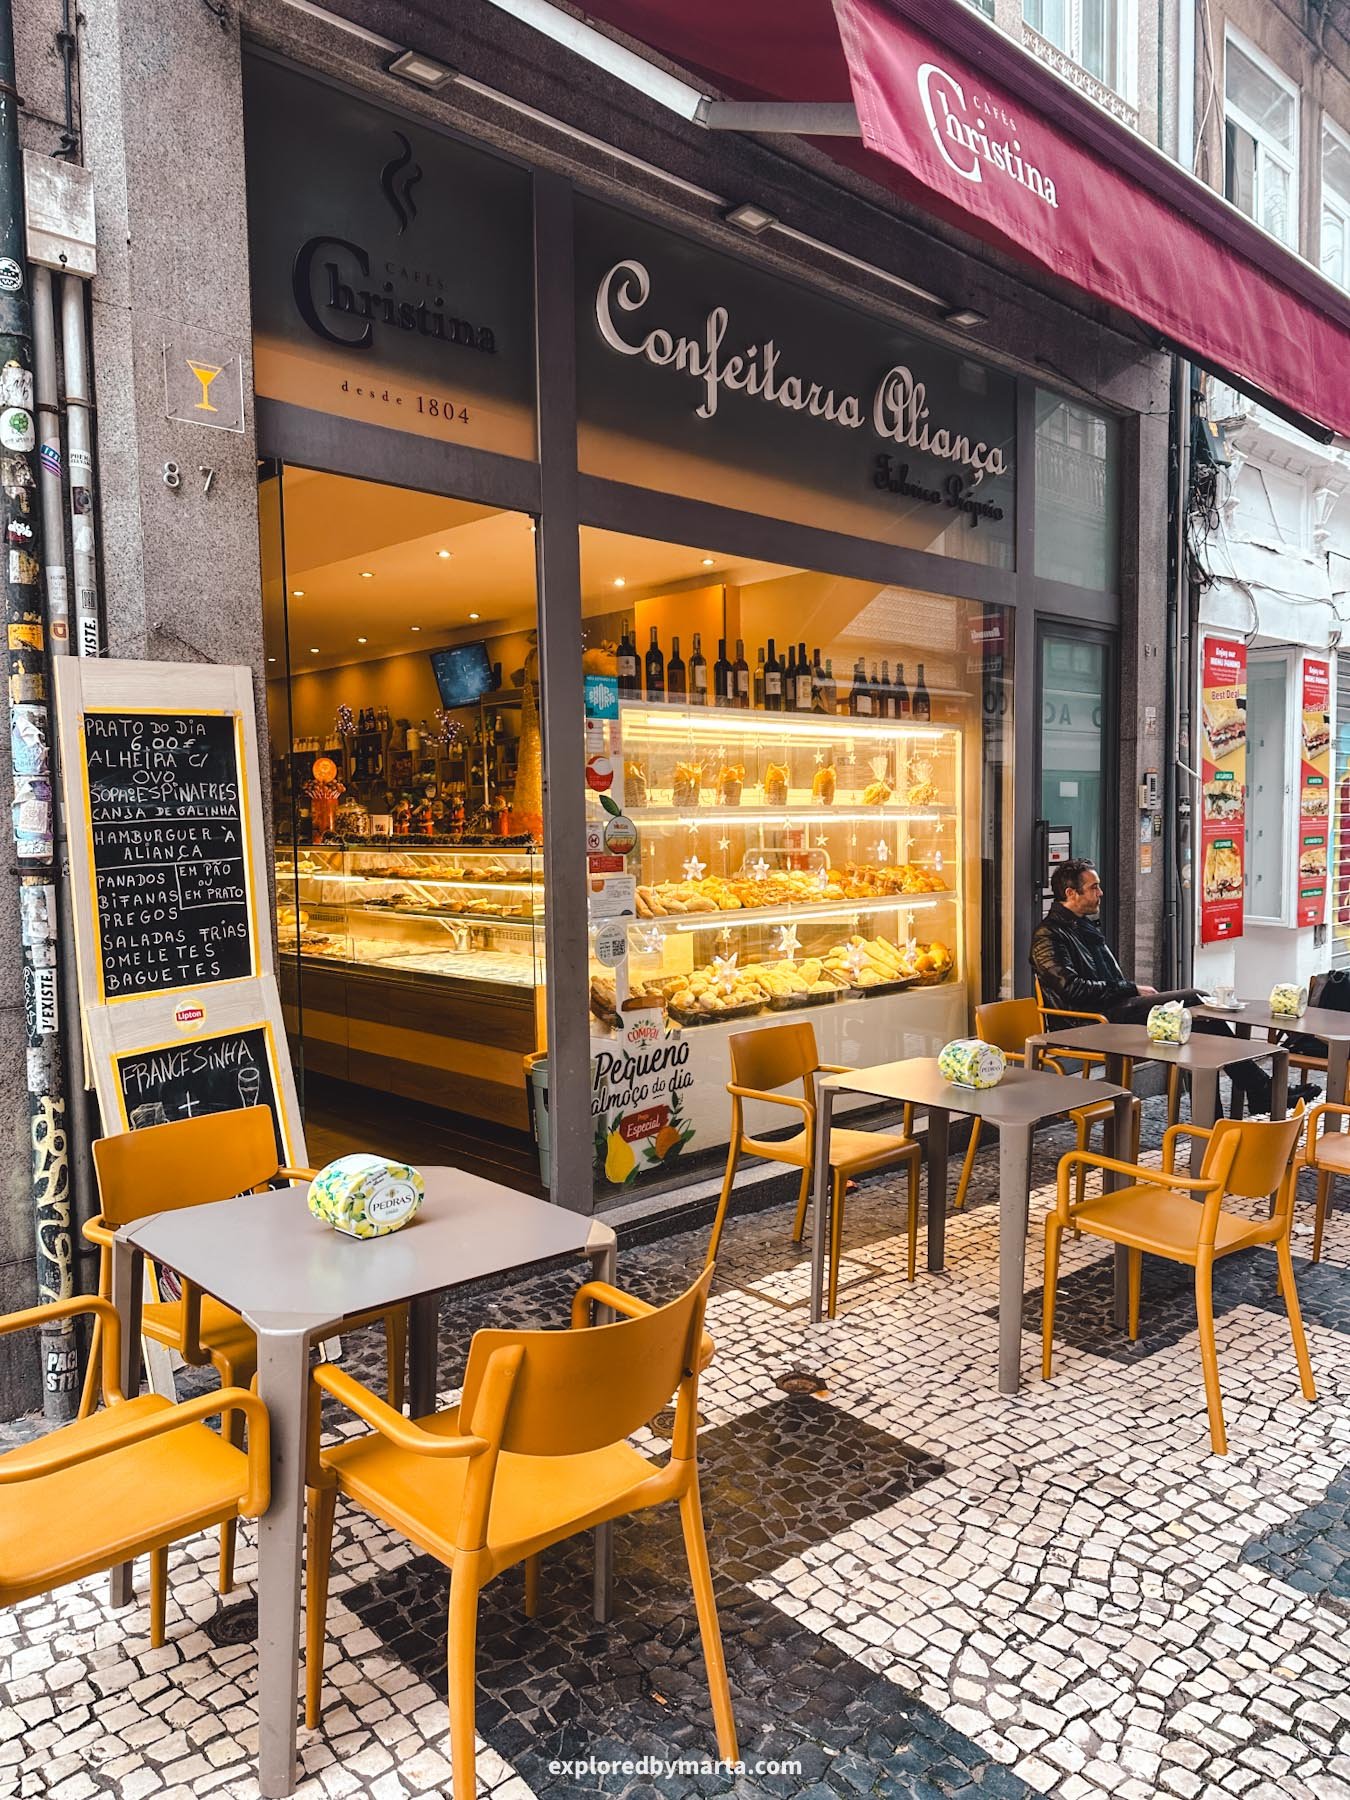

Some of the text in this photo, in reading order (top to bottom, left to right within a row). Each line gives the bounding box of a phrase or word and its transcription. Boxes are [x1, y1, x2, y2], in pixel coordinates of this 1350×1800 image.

[917, 63, 1059, 209] Christina
[292, 236, 497, 354] Christina
[595, 260, 1007, 487] Confeitaria Aliança
[341, 381, 470, 424] desde 1804
[85, 718, 143, 737] PRATO
[150, 722, 169, 734] DO
[88, 750, 177, 769] ALHEIRA
[133, 770, 175, 784] OVO
[92, 804, 237, 820] CANJA DE GALINHA
[95, 828, 212, 845] HAMBURGUER
[96, 861, 231, 889] PANADOS EM PÃO
[185, 890, 201, 900] EM
[208, 886, 244, 899] PRATO
[100, 907, 178, 928] PREGOS
[104, 930, 185, 950] SALADAS
[105, 943, 215, 969] OMELETES
[106, 961, 221, 990] BAGUETES
[41, 970, 55, 1030] J'EXISTE.
[178, 1009, 202, 1021] Lipton
[594, 1041, 690, 1091] Pequeno
[591, 1069, 694, 1116] almoço do dia
[626, 1113, 661, 1138] Especial
[373, 1195, 412, 1212] PEDRAS
[48, 1349, 78, 1371] PAC
